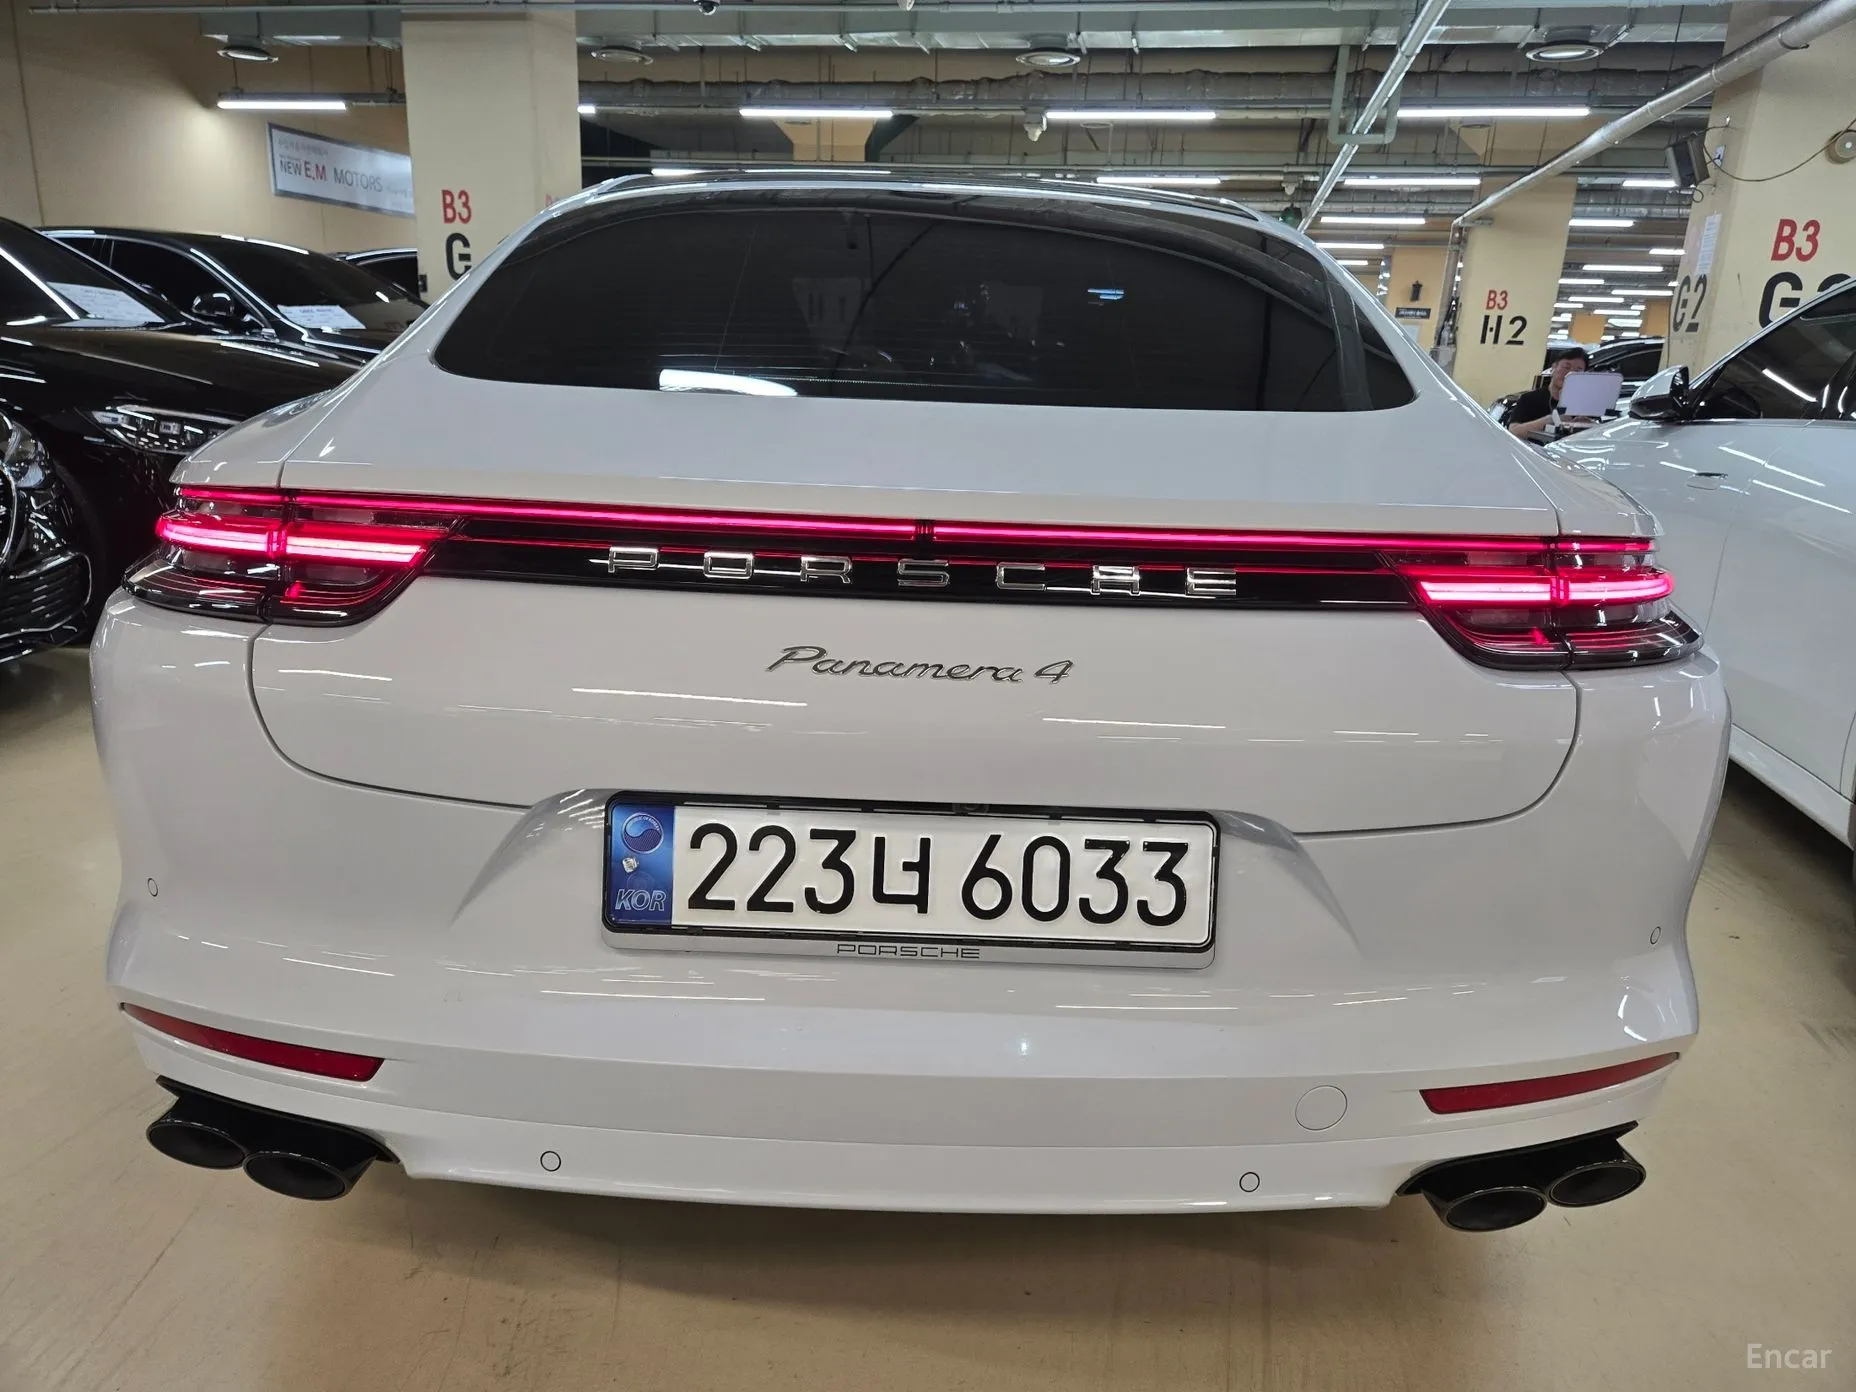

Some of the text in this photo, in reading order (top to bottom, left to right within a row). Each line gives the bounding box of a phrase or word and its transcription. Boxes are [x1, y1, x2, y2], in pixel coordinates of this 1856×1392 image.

[279, 159, 302, 177] NEW
[333, 167, 383, 193] MOTORS
[441, 189, 472, 224] B3
[1770, 218, 1821, 262] B3
[1485, 289, 1509, 311] B3
[1672, 273, 1708, 332] G2
[1758, 271, 1851, 328] G
[1480, 314, 1528, 346] H2
[607, 546, 1238, 596] PORSCHE
[765, 645, 1075, 684] Panamera 4
[688, 822, 1190, 927] 223너 6033
[614, 888, 666, 912] KOR
[836, 943, 980, 959] PORSCHE
